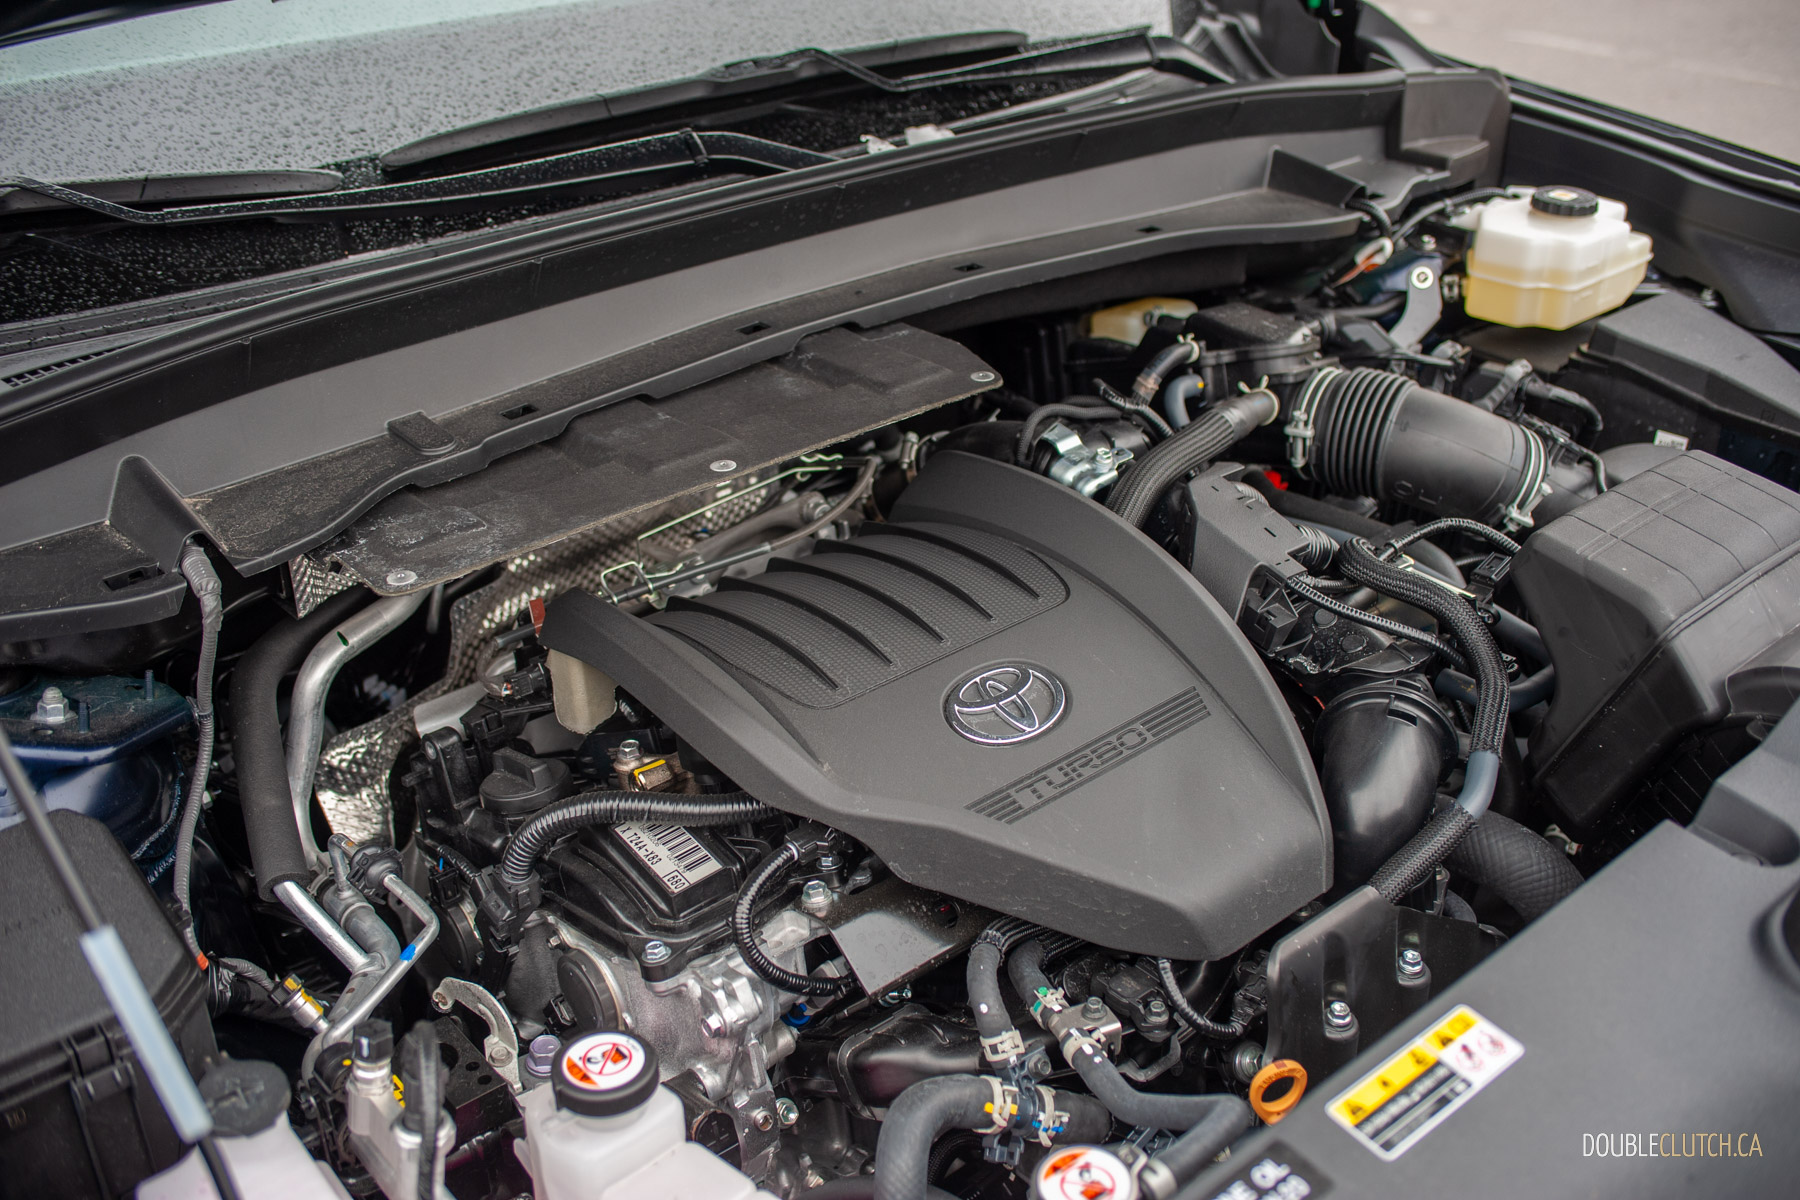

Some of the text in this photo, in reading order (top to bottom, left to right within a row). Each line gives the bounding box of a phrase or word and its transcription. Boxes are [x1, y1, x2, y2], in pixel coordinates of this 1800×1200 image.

[1014, 727, 1148, 800] TURBO
[627, 832, 662, 866] T24A-X83
[667, 874, 686, 890] 680
